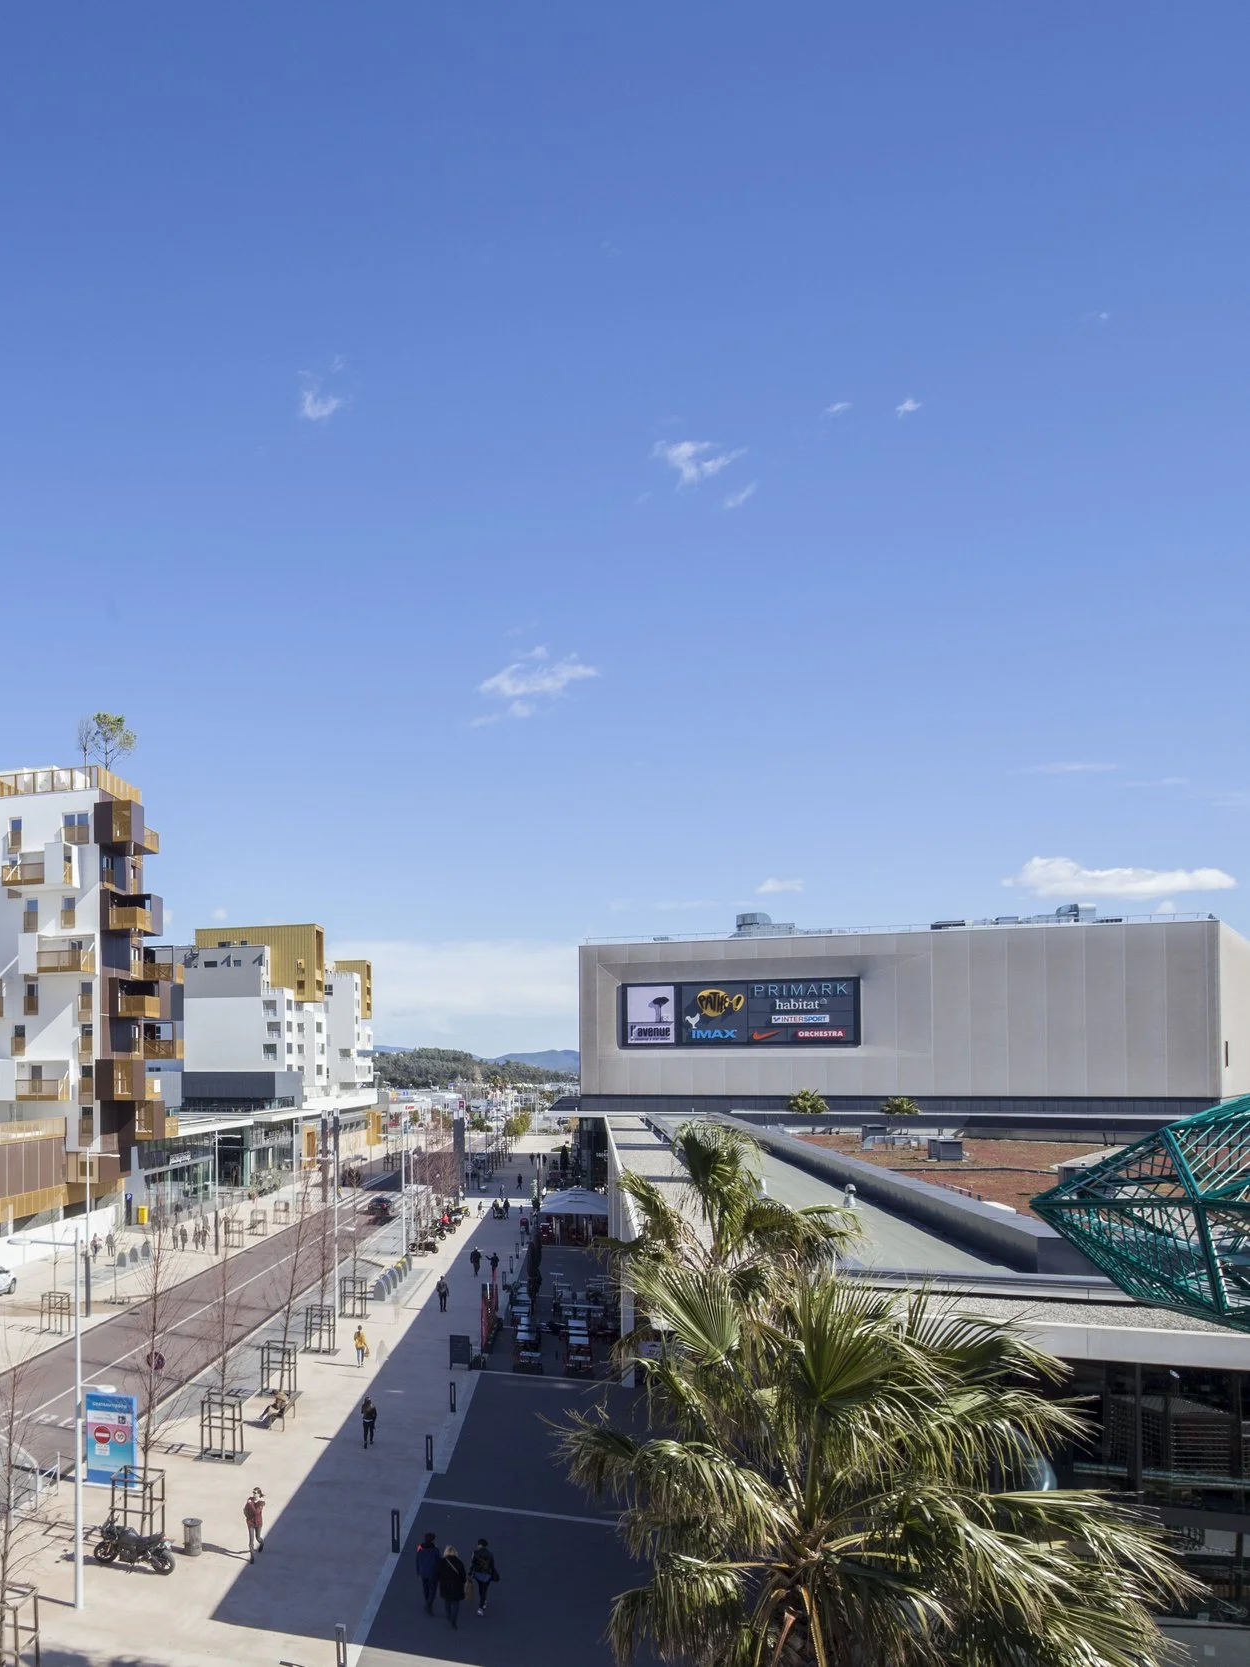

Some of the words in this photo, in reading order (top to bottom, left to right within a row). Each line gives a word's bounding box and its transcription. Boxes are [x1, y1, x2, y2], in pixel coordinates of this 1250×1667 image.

[754, 983, 848, 996] PRIMARK
[775, 998, 820, 1010] habitat
[692, 1029, 736, 1039] IMAX
[798, 1030, 844, 1038] ORCHESTRA
